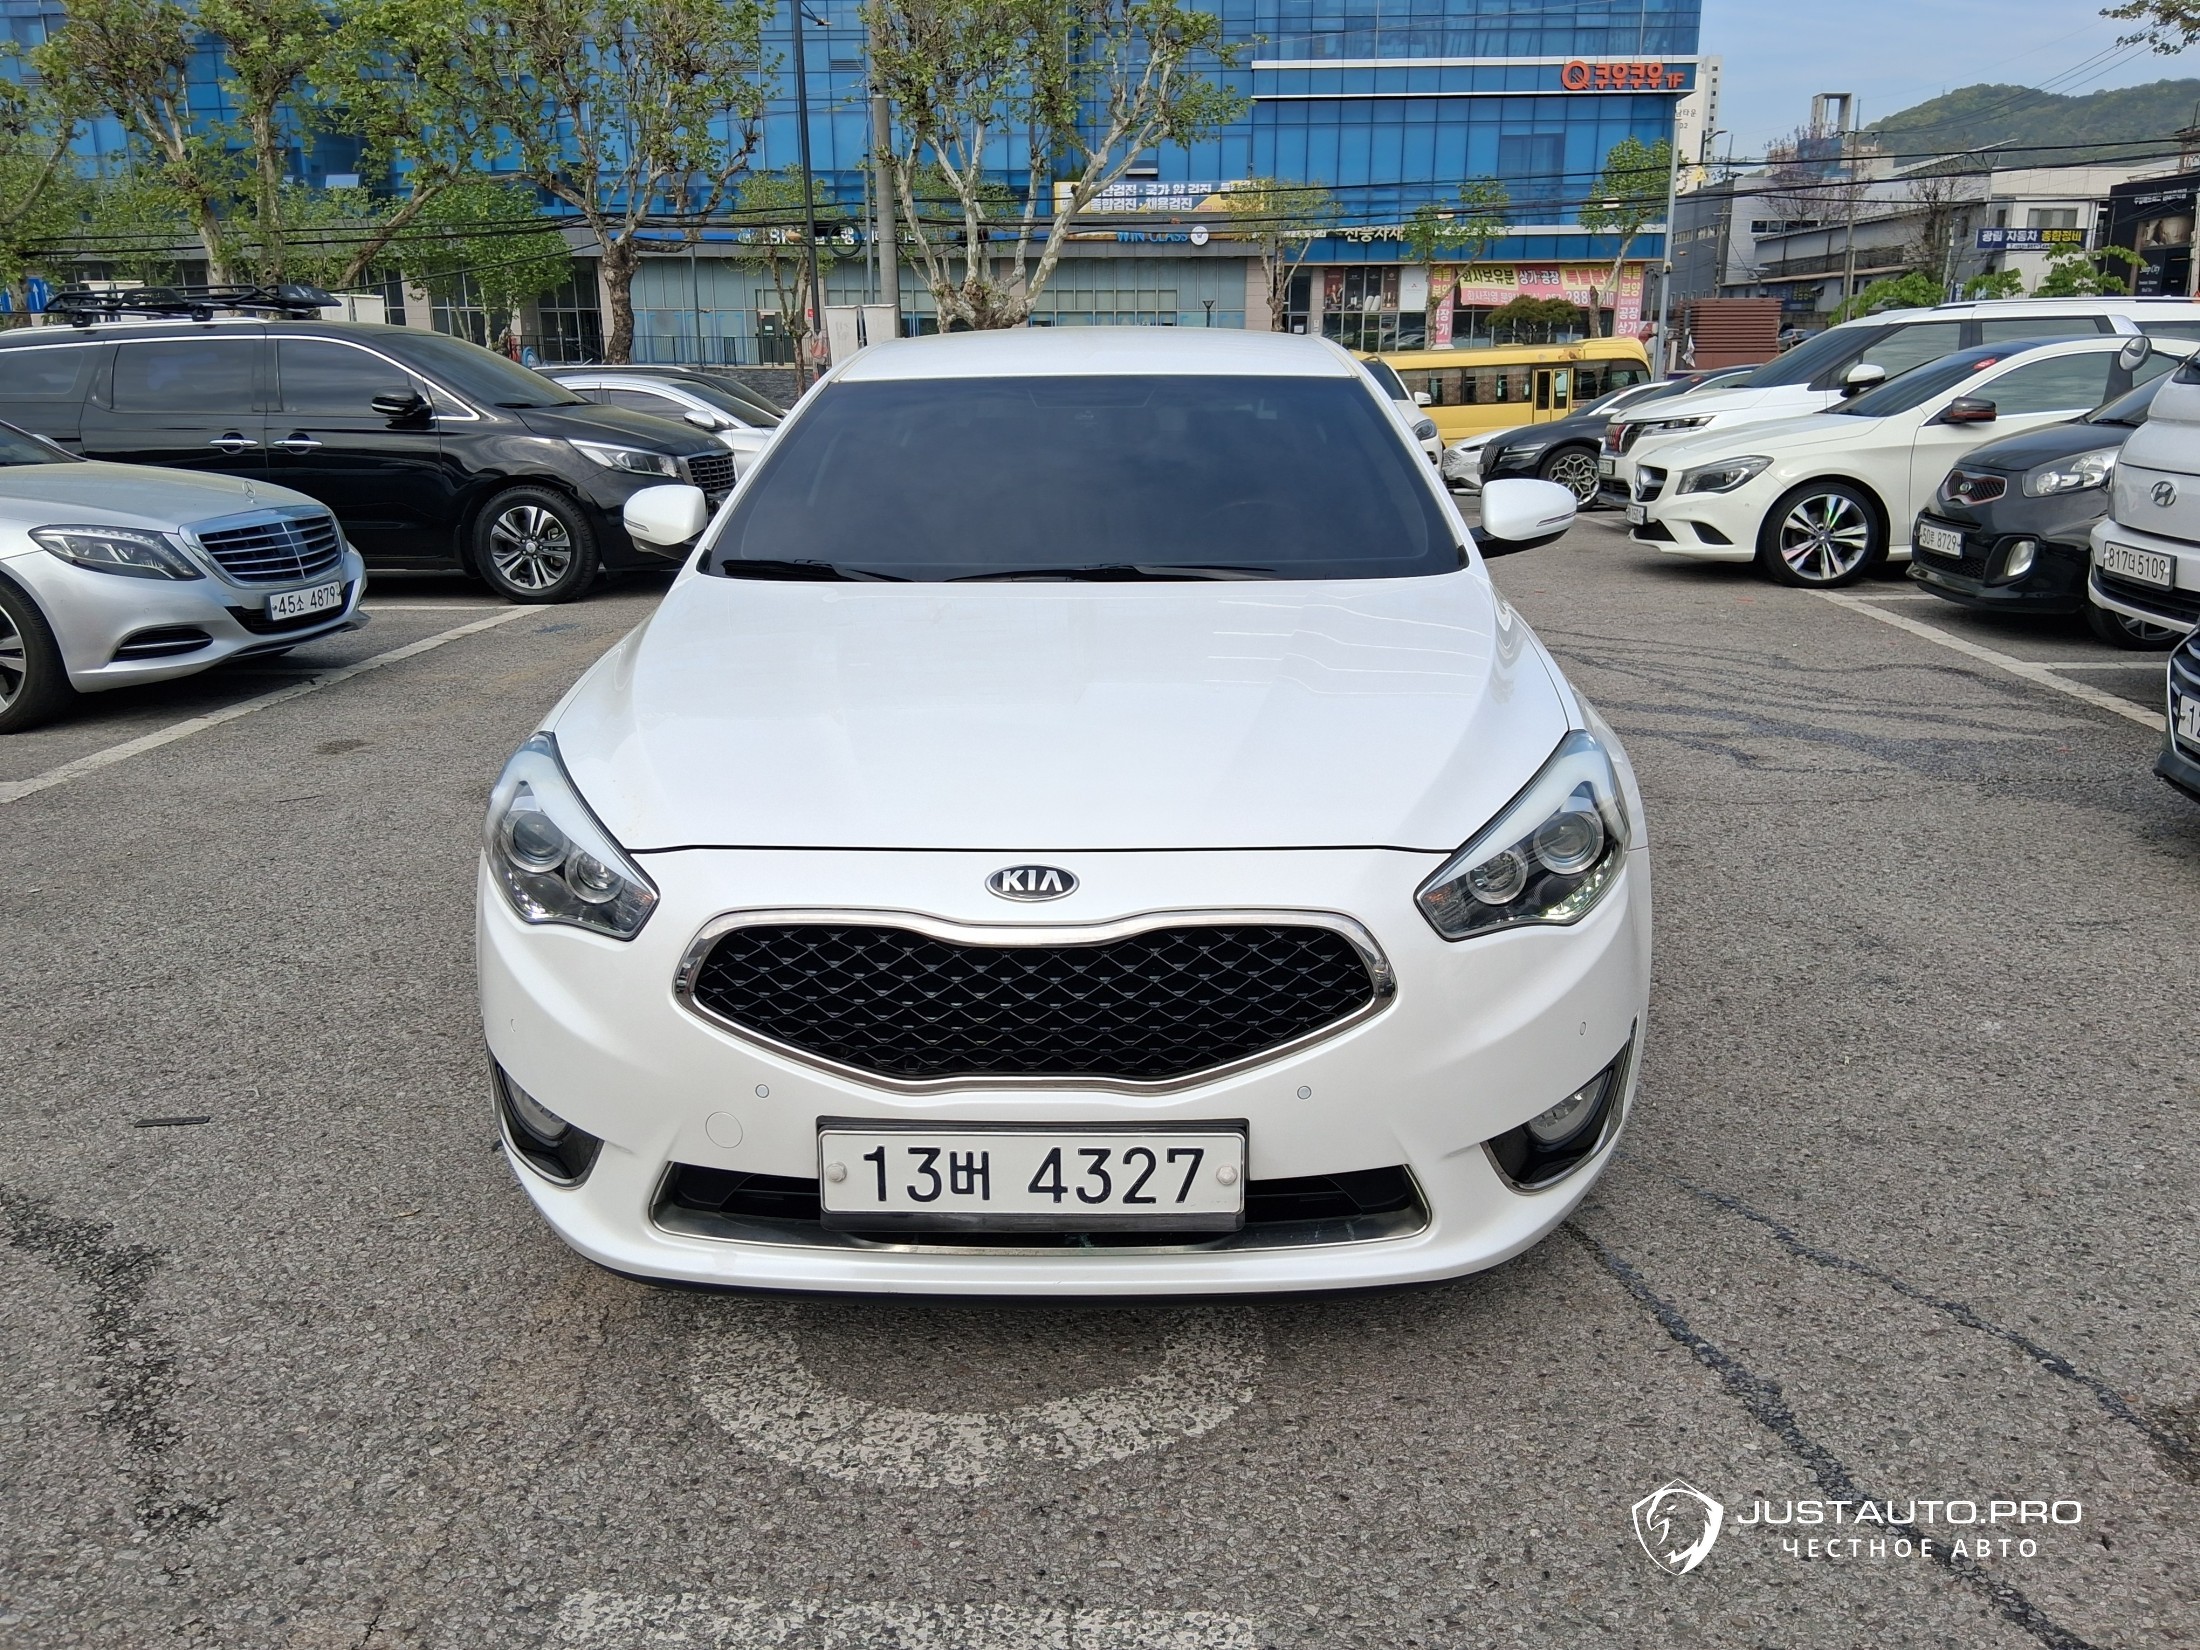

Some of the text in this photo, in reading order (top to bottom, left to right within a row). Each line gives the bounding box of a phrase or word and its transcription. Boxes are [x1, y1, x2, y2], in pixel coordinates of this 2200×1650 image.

[1595, 62, 1664, 89] 쿠우쿠우
[1666, 72, 1685, 88] 1F
[1090, 198, 1137, 211] 종합검진
[1146, 197, 1193, 211] 채용검진
[1116, 231, 1188, 242] WIN CLASS
[2006, 230, 2038, 242] 자동차
[1462, 268, 1516, 285] 회사보유분
[1621, 282, 1641, 297] 분양
[1619, 307, 1639, 320] 공장
[1618, 321, 1637, 334] 상가
[1937, 531, 1957, 551] 8729
[278, 585, 336, 615] 45소 4879
[1002, 869, 1063, 892] KIA
[862, 1145, 1205, 1204] 13버 4327
